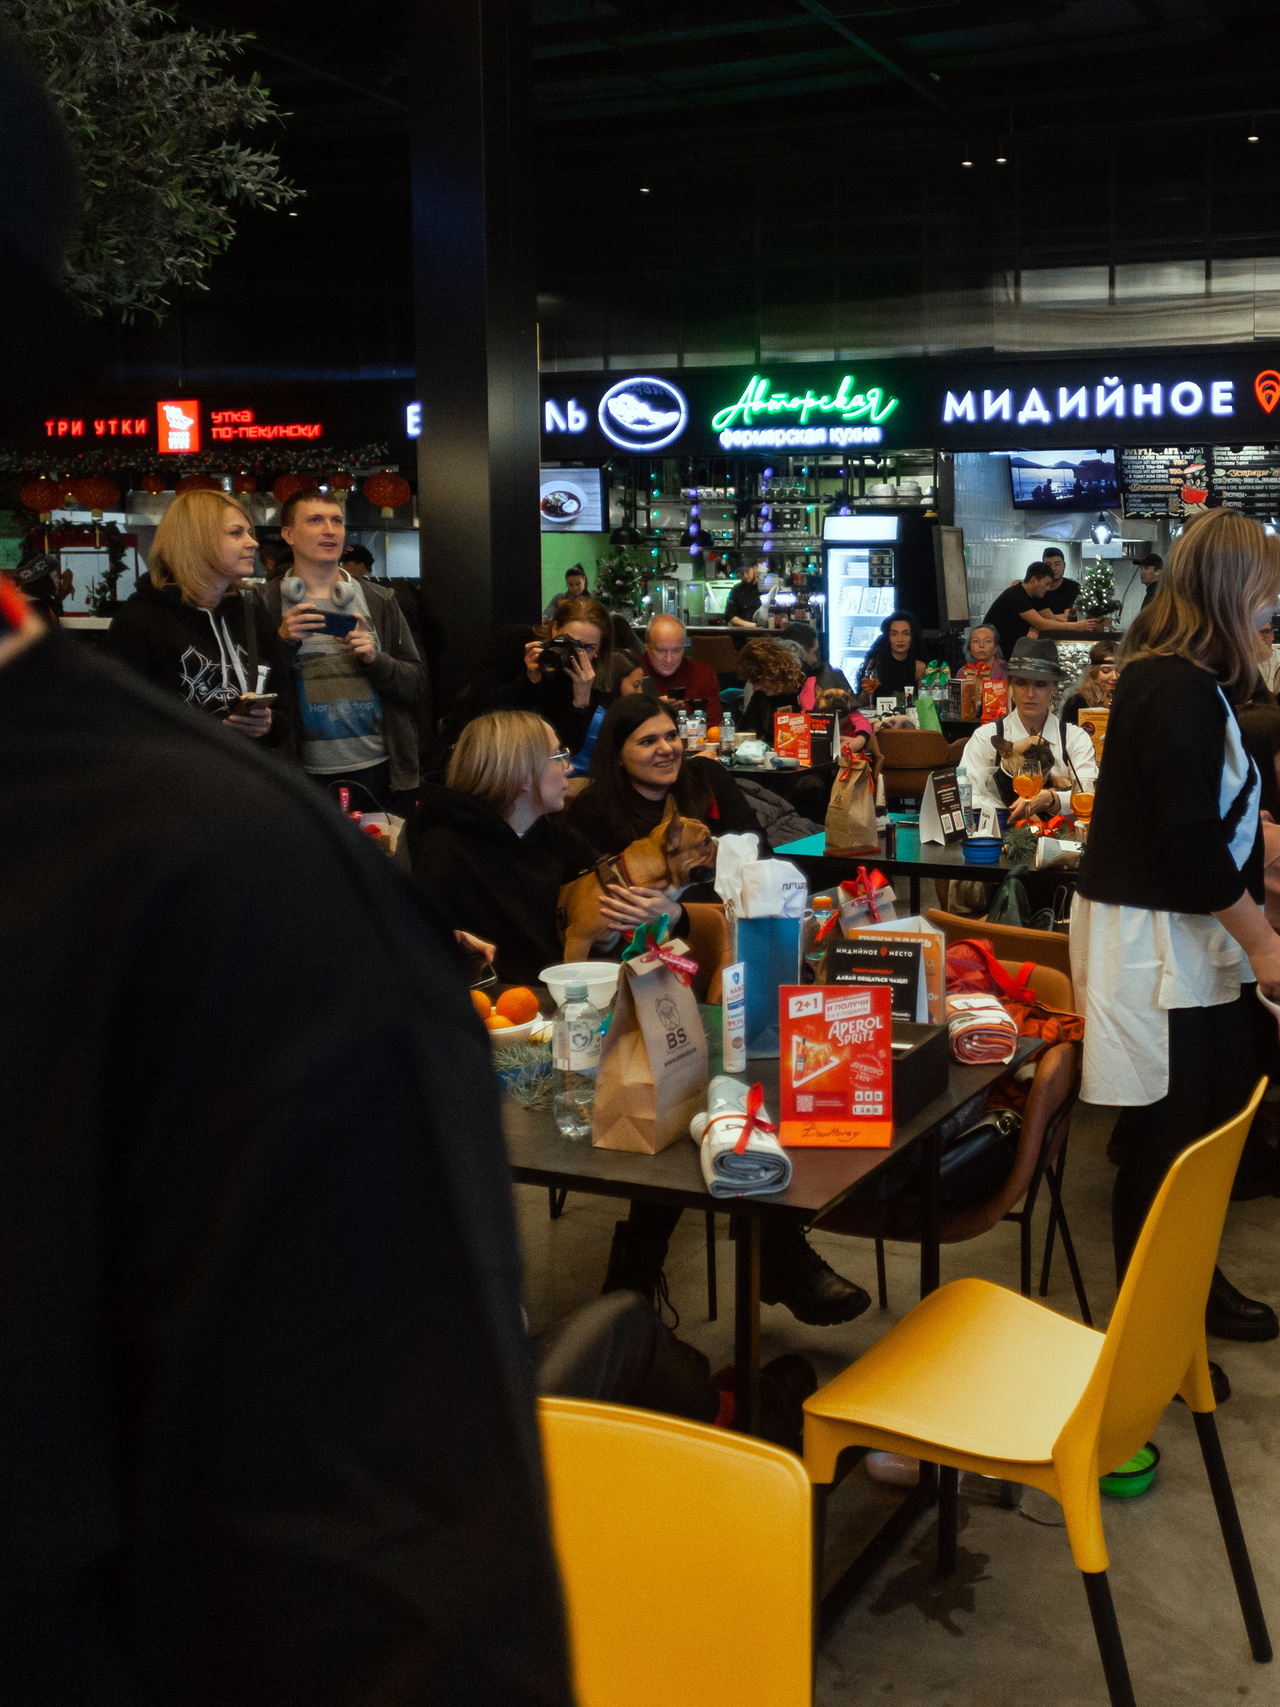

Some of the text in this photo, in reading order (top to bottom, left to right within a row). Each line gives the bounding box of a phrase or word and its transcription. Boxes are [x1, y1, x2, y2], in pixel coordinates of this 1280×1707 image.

[711, 374, 898, 431] Авторская
[943, 376, 1235, 423] МИДИЙНОЕ
[45, 418, 147, 437] ТРИ УТКИ
[211, 424, 321, 440] ПО-ПЕКИНСКИ
[880, 703, 892, 711] 13
[836, 947, 878, 956] МИДИЙНОЕ
[794, 997, 818, 1013] 2+1
[834, 999, 869, 1011] ПОЛУЧИ
[828, 1015, 883, 1040] APEROL
[665, 1027, 687, 1050] BS
